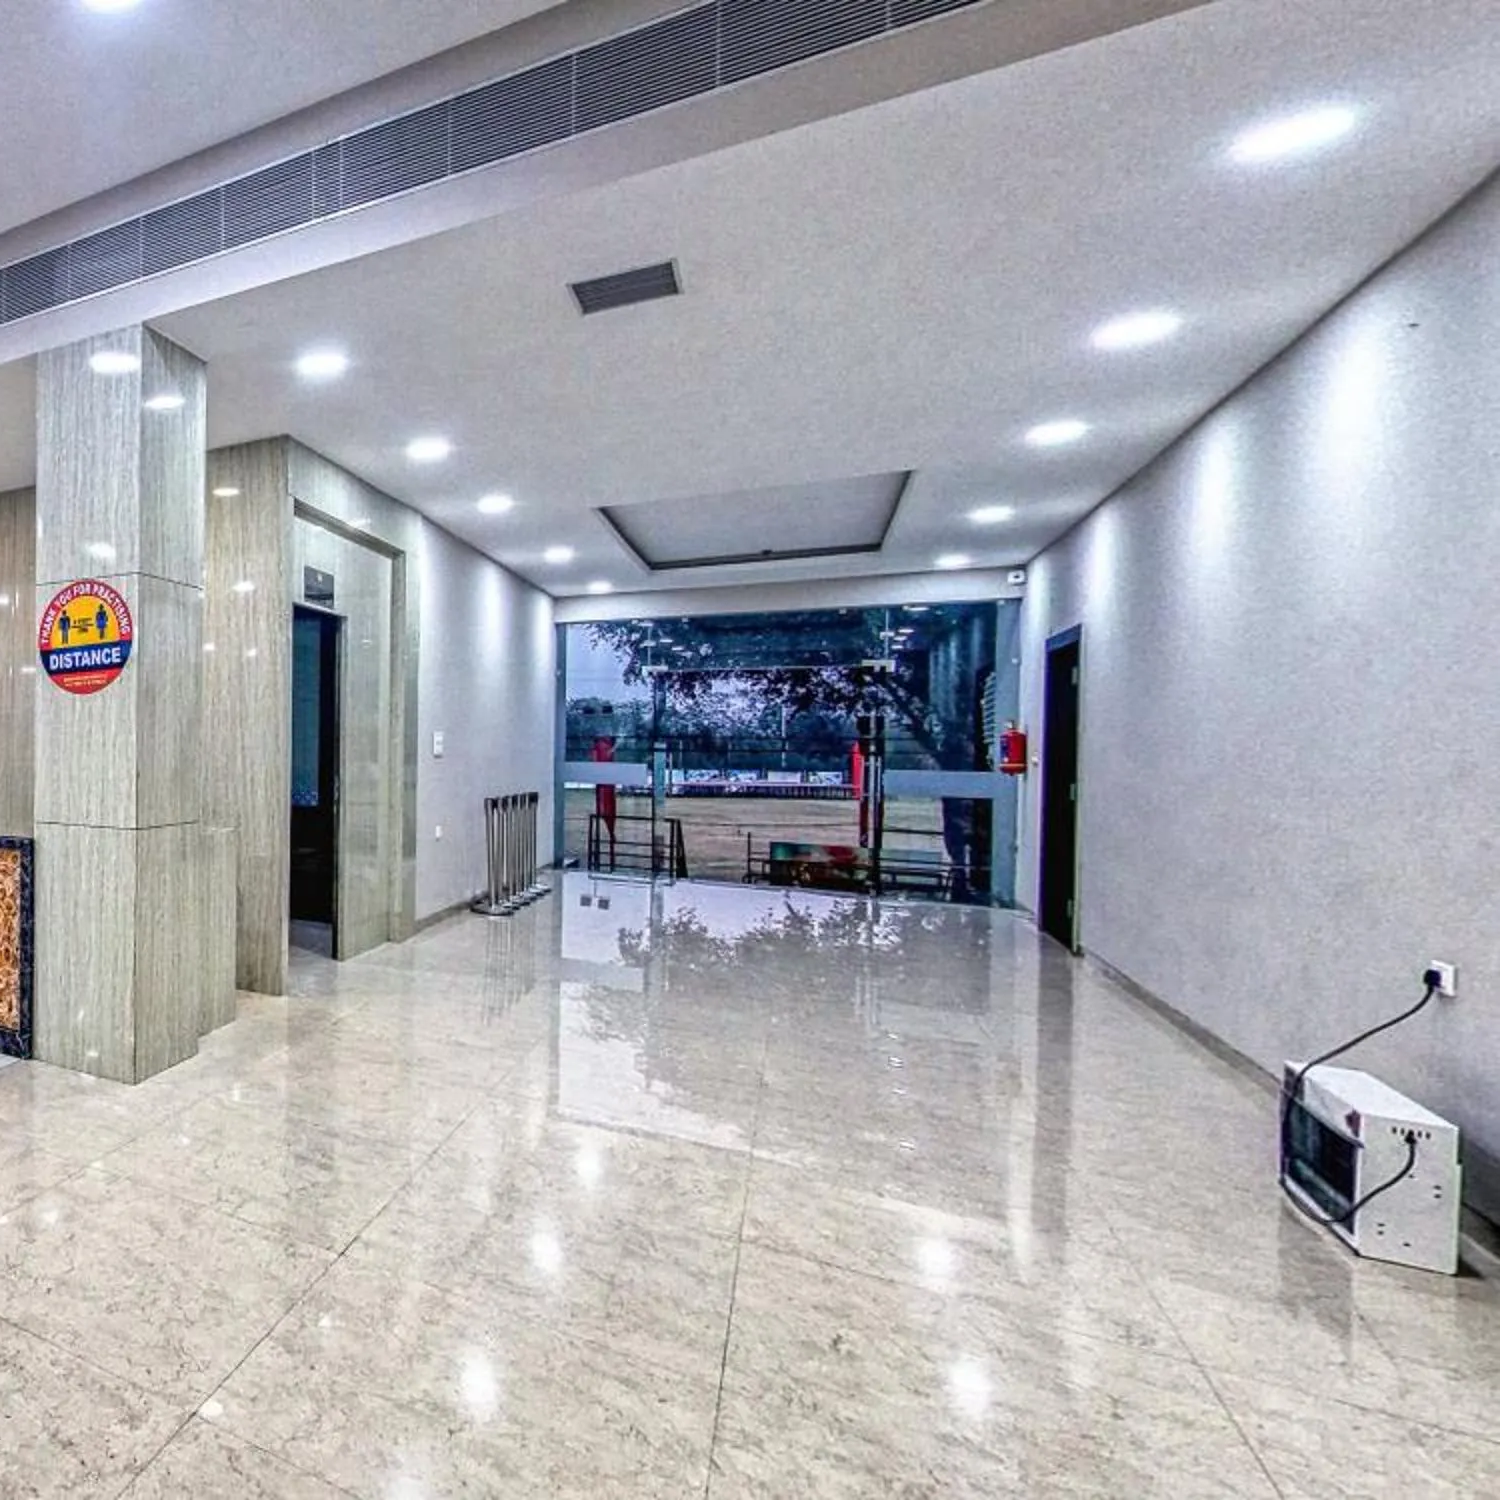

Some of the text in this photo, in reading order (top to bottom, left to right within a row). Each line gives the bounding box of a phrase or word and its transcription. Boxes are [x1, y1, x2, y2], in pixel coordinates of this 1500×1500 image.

[41, 607, 56, 644] THANK
[53, 589, 72, 609] YOU
[73, 583, 92, 597] FOR
[49, 648, 121, 669] DISTANCE
